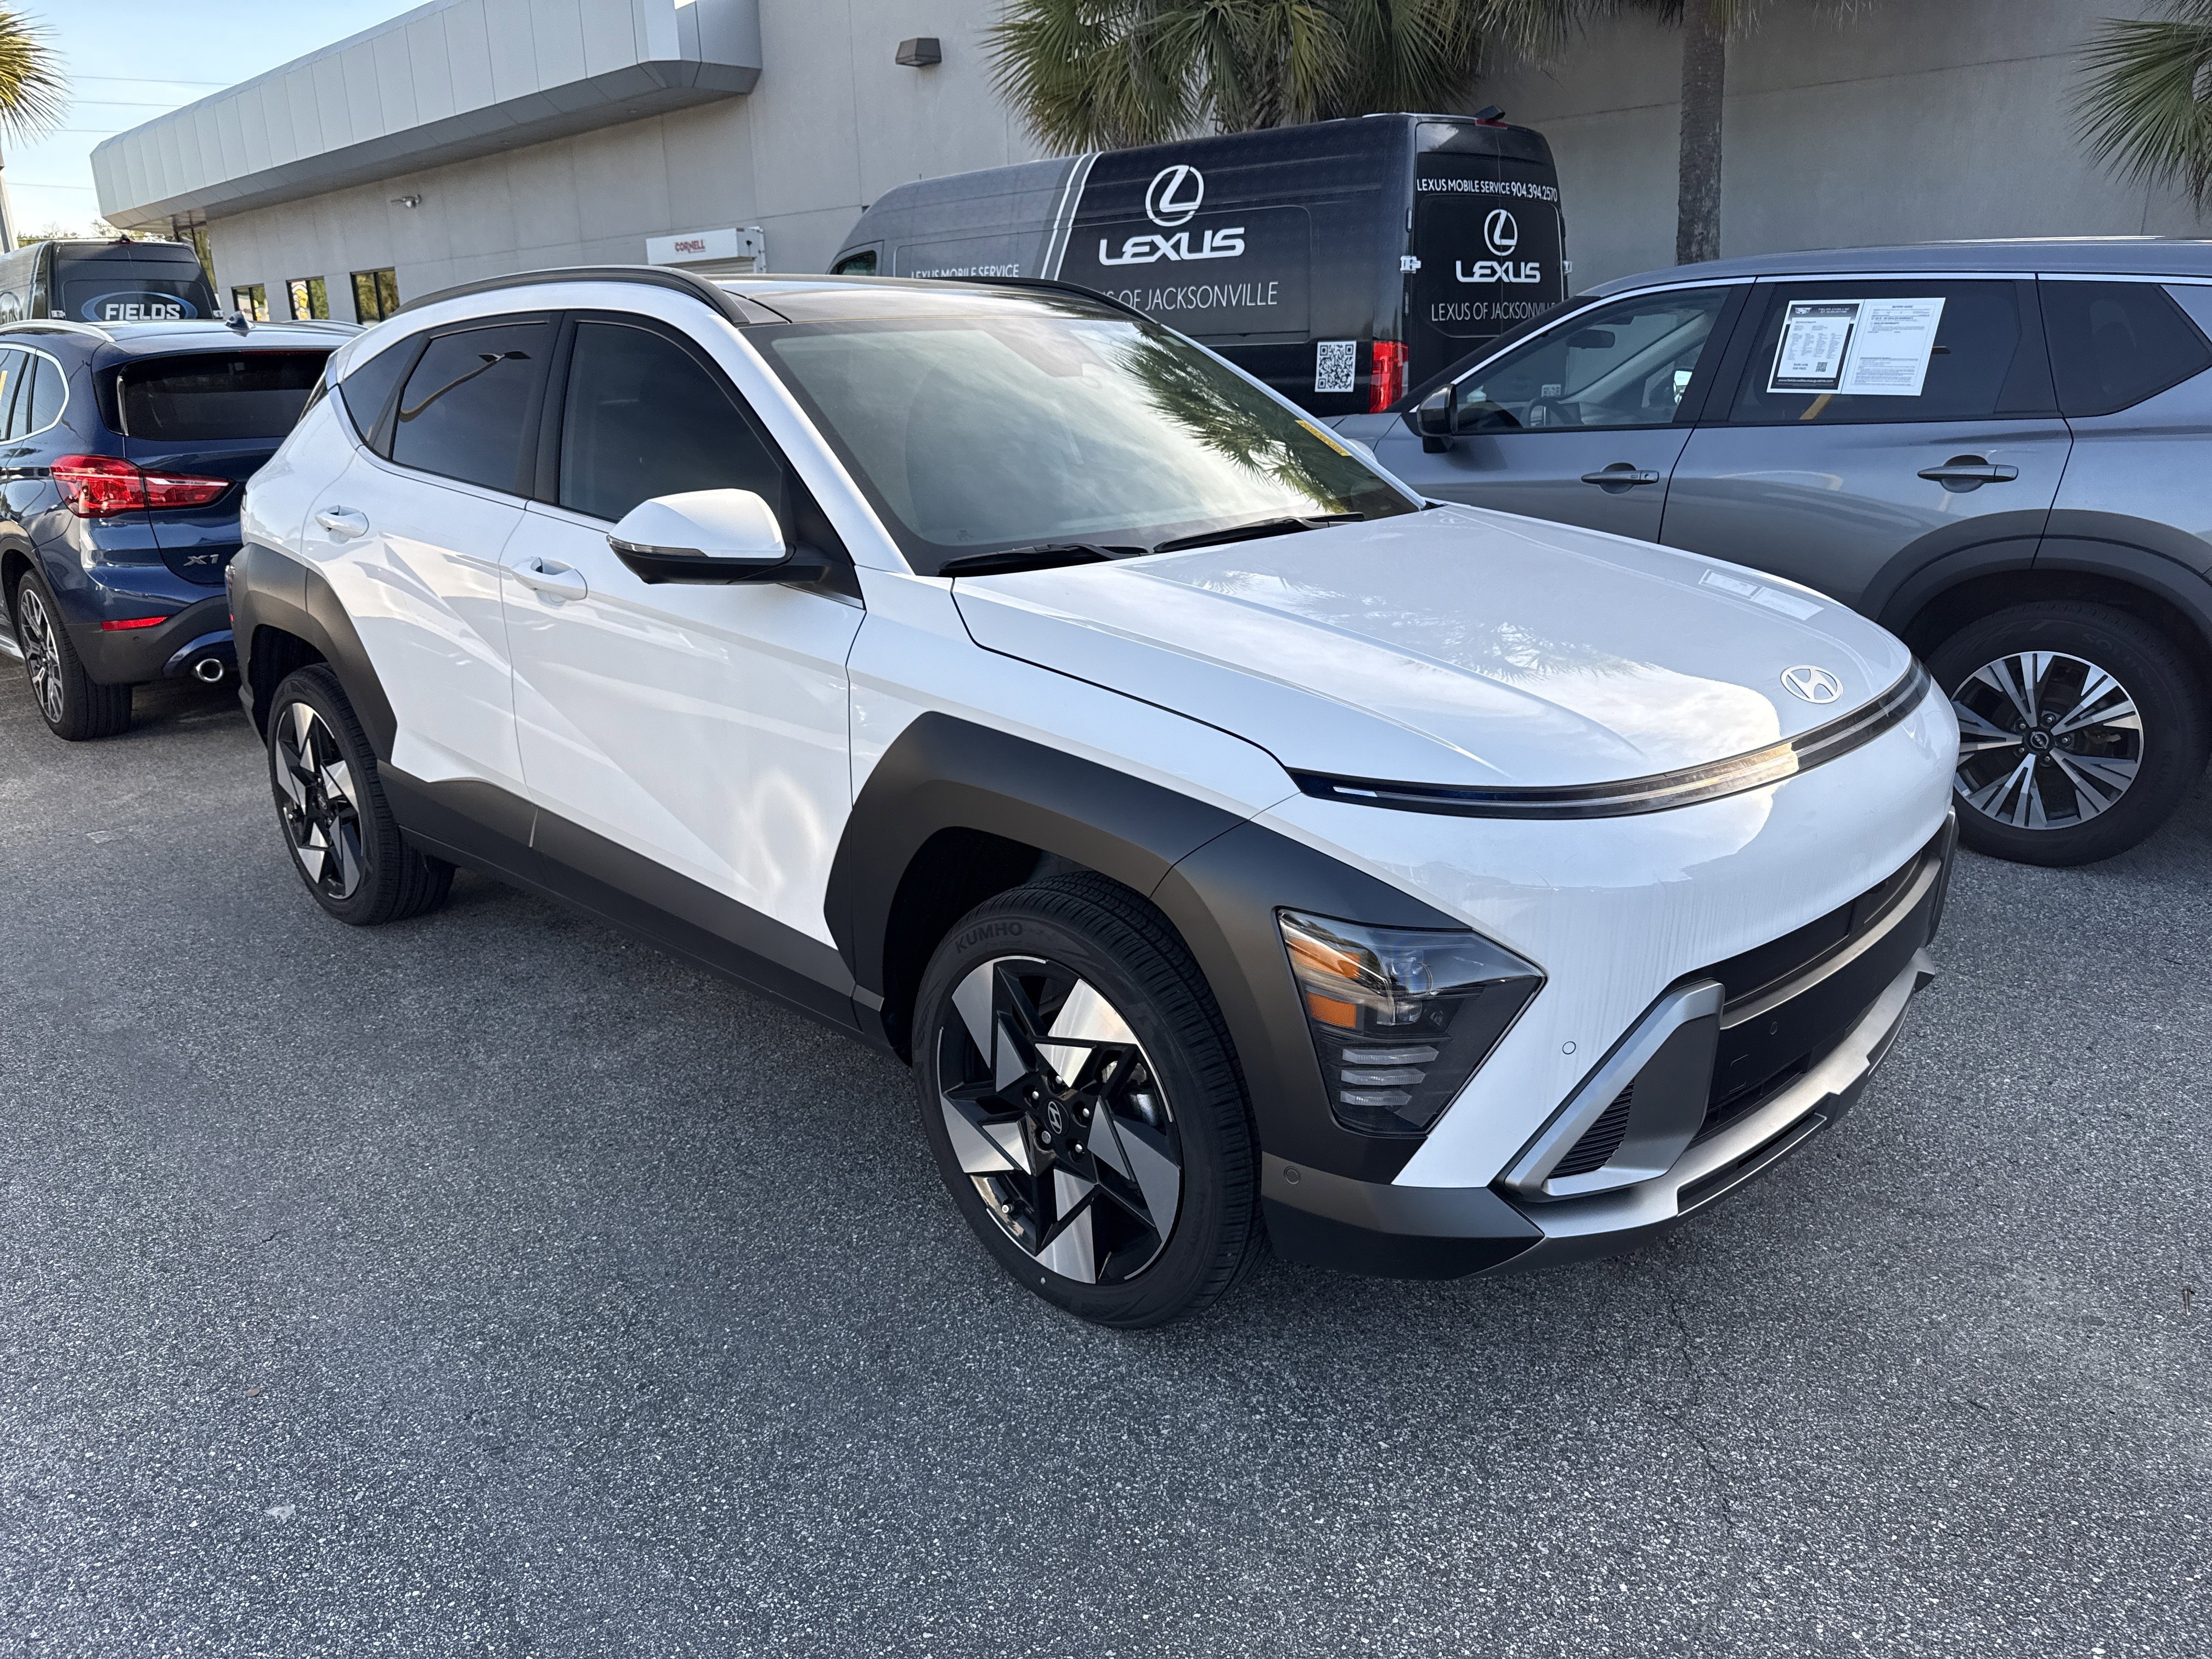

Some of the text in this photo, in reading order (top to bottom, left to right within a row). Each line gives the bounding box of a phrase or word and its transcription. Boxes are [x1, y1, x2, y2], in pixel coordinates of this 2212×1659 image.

[1417, 179, 1558, 202] LEXUS MOBILE SERVICE 904.394.2570
[675, 239, 706, 253] CORNELL
[1098, 227, 1245, 266] LEXUS
[978, 263, 1020, 278] SERVICE
[1455, 260, 1541, 283] LEXUS
[1118, 281, 1279, 311] OF JACKSONVILLE
[105, 303, 180, 320] FIELDS
[1431, 302, 1555, 321] LEXUS OF JACKSONVI
[183, 554, 219, 567] X1
[955, 922, 1023, 953] KUMHO
